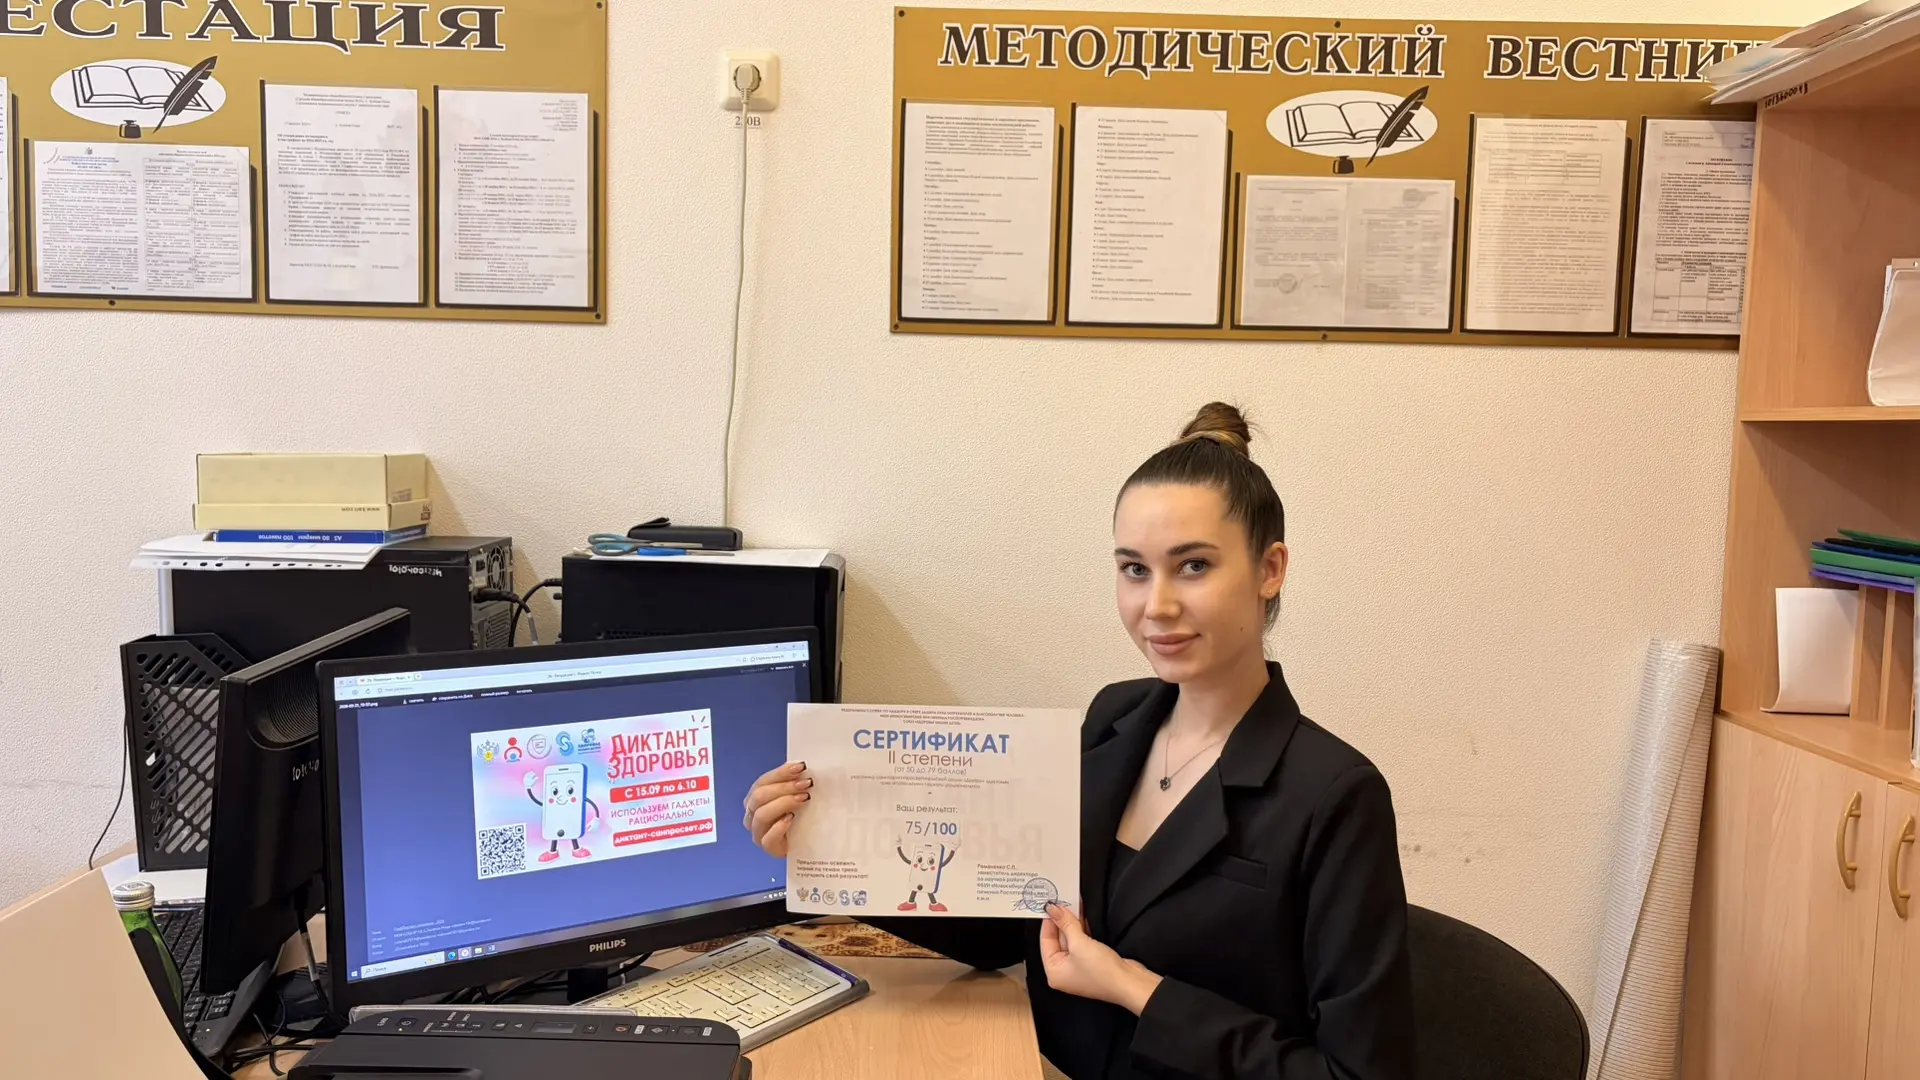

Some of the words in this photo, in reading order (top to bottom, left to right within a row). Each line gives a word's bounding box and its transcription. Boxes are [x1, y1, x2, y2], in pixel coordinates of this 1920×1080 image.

[938, 22, 1447, 79] МЕТОДИЧЕСКИЙ
[1484, 35, 1772, 82] ВЕСТНИ
[734, 115, 761, 127] 20В
[611, 728, 699, 757] ДИКТАНТ
[853, 729, 1010, 754] СЕРТИФИКАТ
[607, 747, 709, 779] ЗДОРОВЬЯ
[888, 750, 896, 764] II
[901, 753, 972, 767] степени
[894, 766, 904, 774] (от
[937, 767, 967, 775] баллов)
[625, 788, 633, 798] С
[636, 785, 660, 797] 15.09
[663, 785, 675, 793] по
[677, 780, 697, 791] 6.10
[611, 803, 670, 818] ИСПОЛЬЗУЕМ
[671, 797, 710, 809] ГАДЖЕТЫ
[896, 804, 914, 812] Ваш
[916, 806, 958, 814] результат:
[629, 809, 694, 825] РАЦИОНАЛЬНО
[615, 821, 713, 844] диктант-санпросвет.рф
[906, 821, 957, 836] 75/100
[589, 938, 627, 953] PHILIPS
